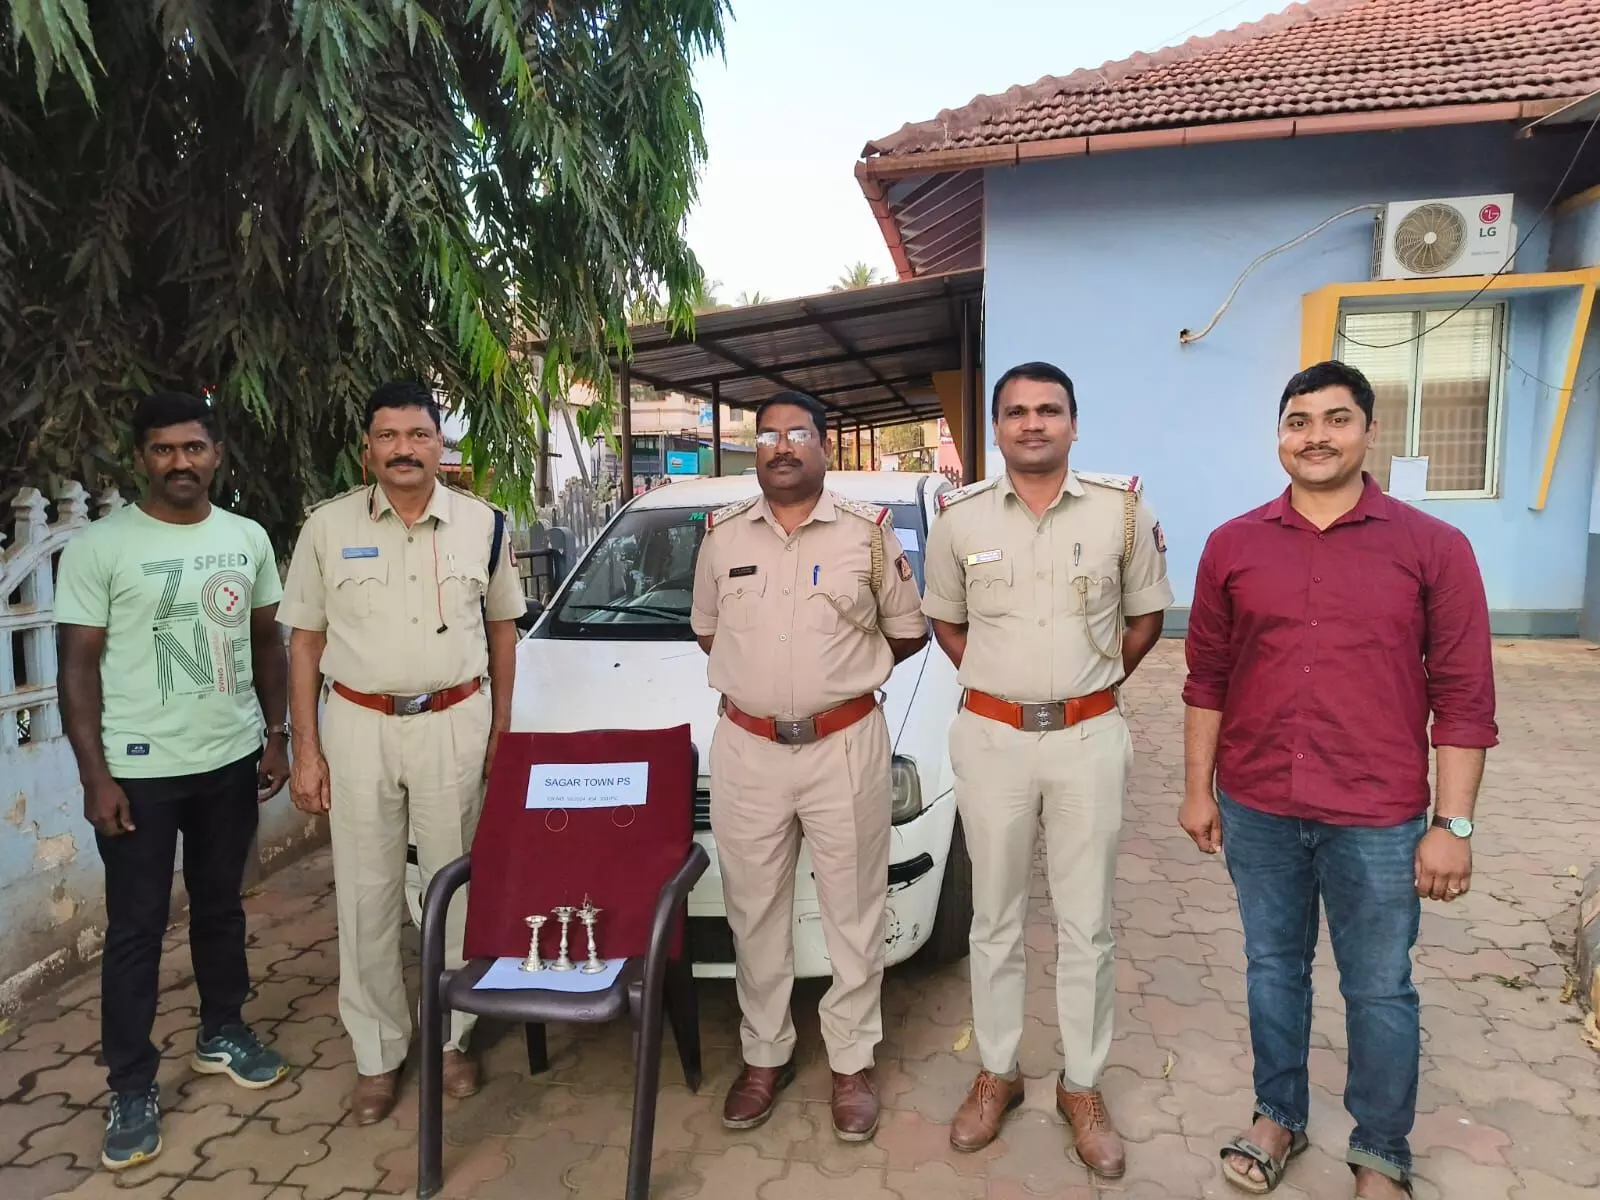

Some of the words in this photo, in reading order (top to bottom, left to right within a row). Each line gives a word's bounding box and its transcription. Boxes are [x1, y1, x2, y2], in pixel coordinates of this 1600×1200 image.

[1480, 227, 1497, 237] LG
[193, 553, 248, 571] SPEED
[544, 778, 581, 787] SAGAR
[583, 778, 615, 787] TOWN
[616, 777, 631, 786] PS
